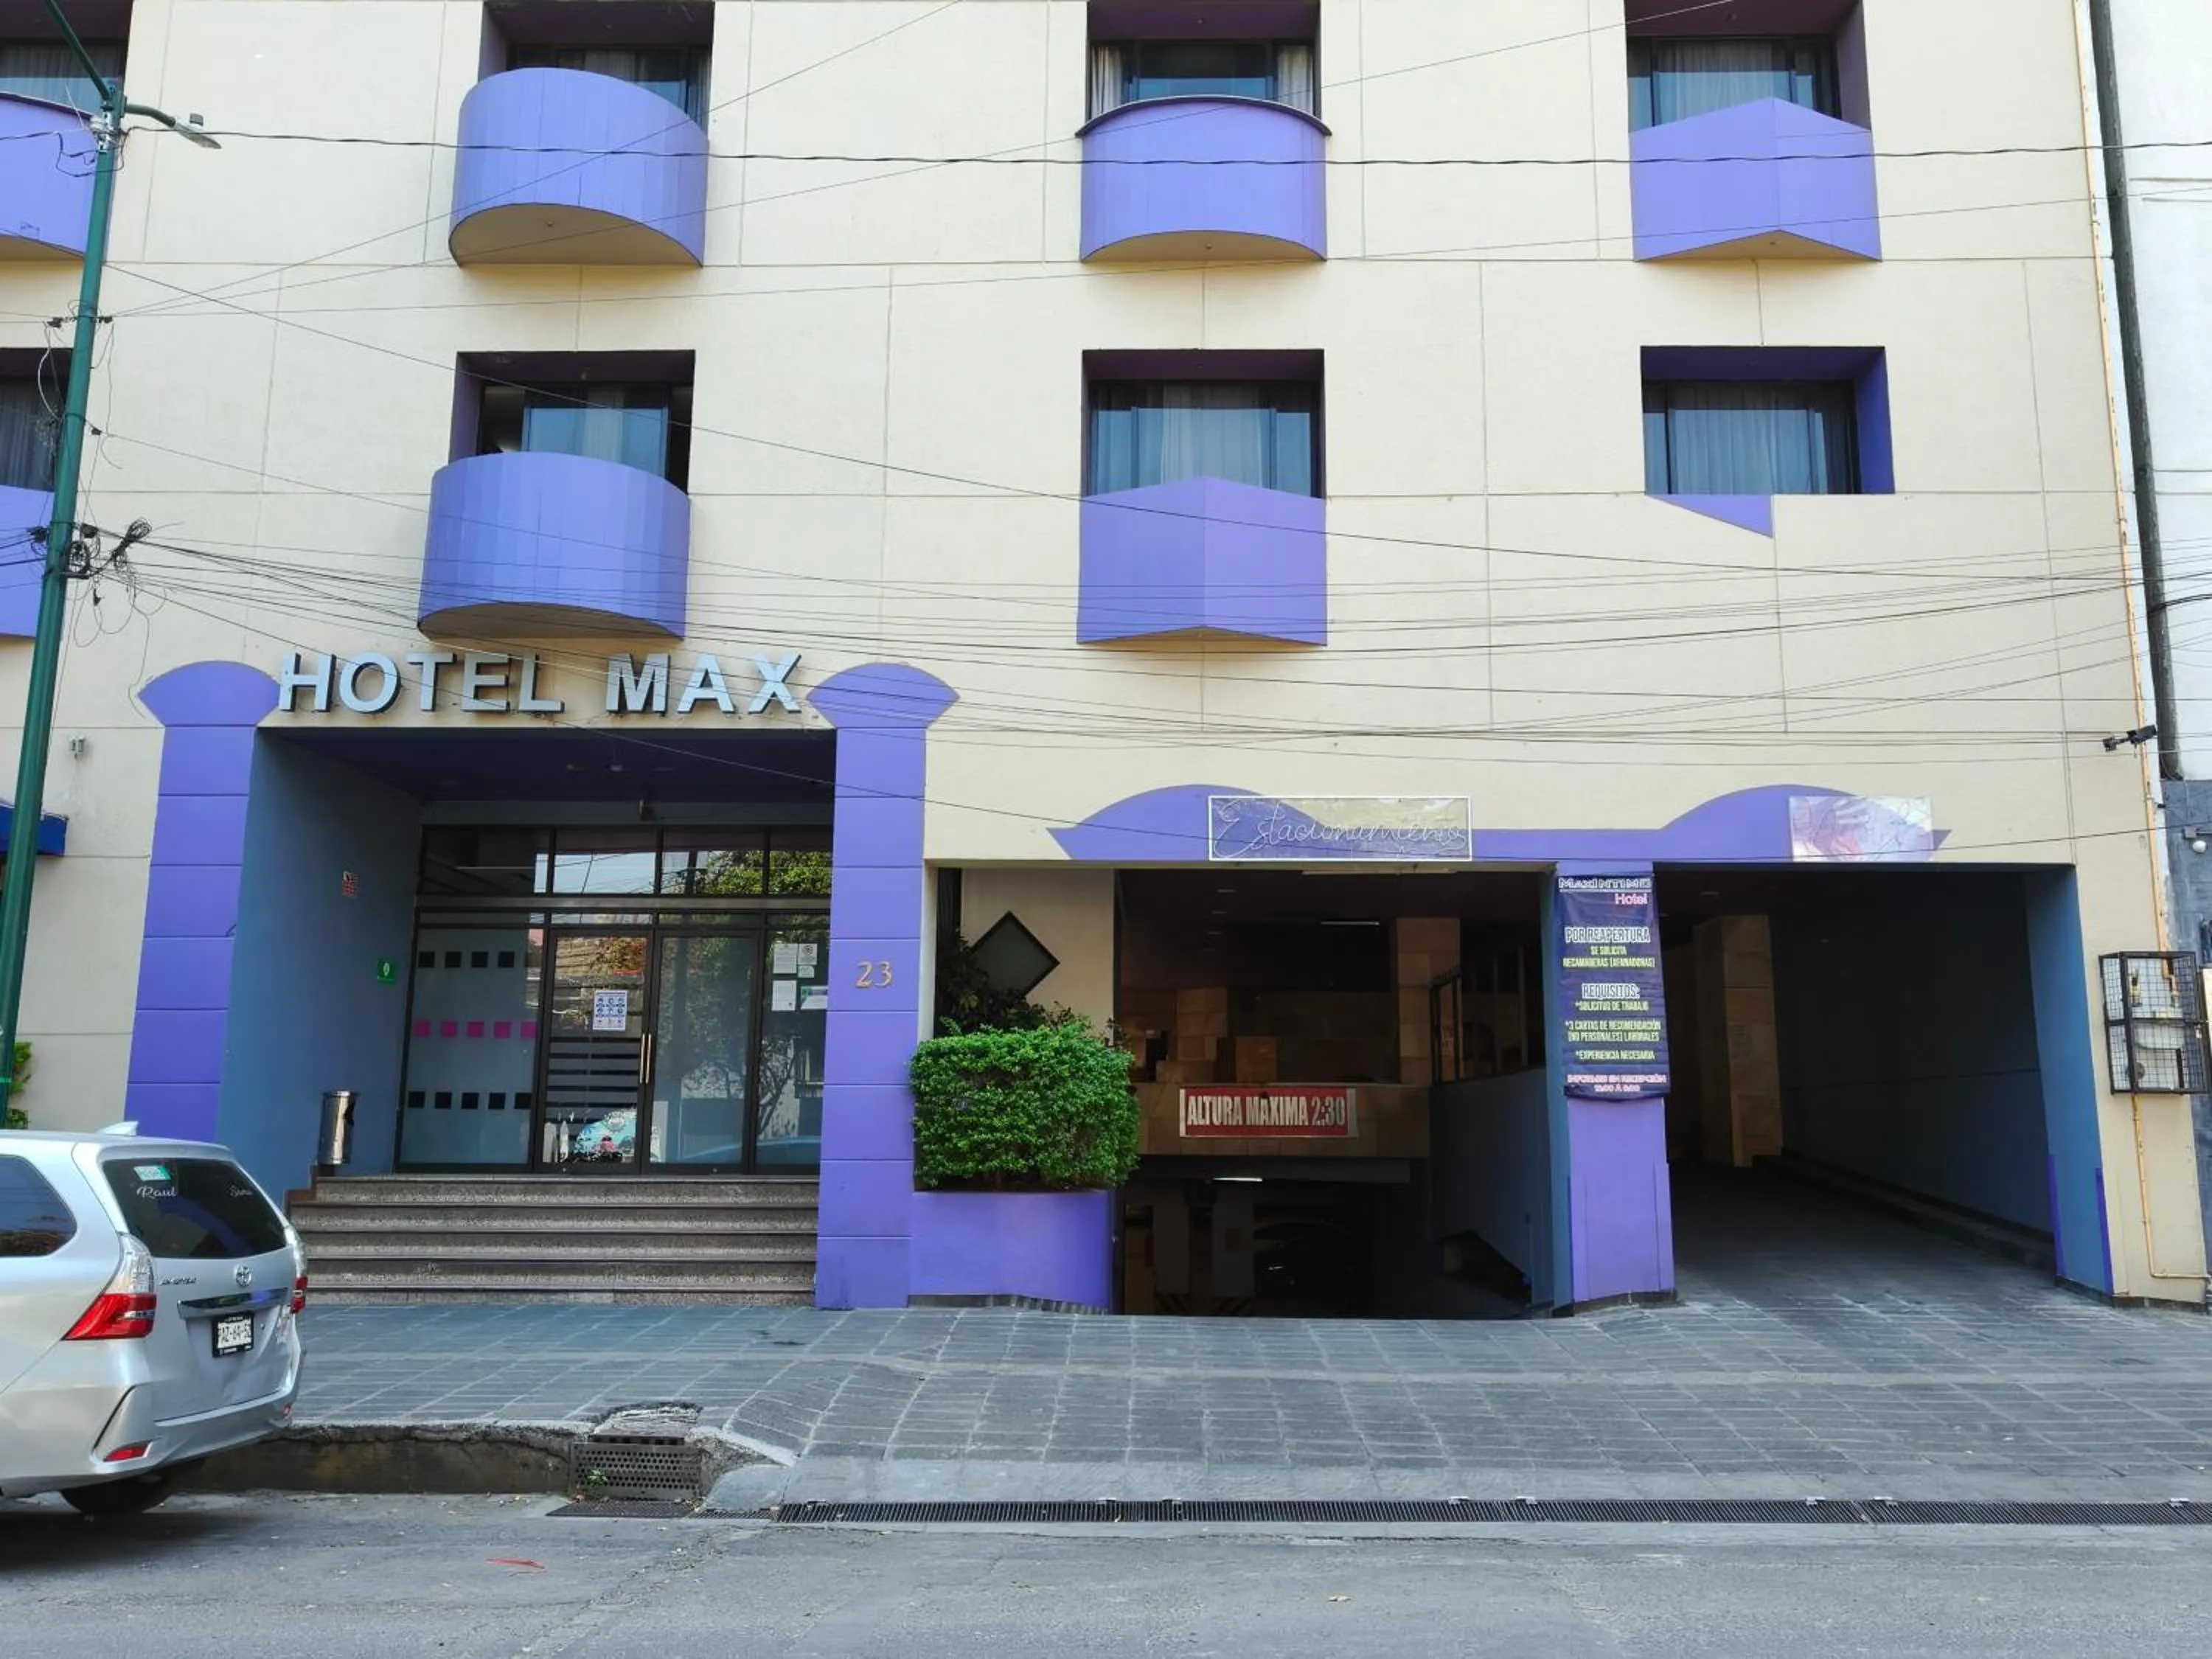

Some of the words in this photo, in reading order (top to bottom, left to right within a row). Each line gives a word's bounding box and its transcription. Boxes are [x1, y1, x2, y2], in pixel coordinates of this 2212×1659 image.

[278, 653, 565, 713] HOTEL
[605, 653, 802, 714] MAX
[1615, 893, 1648, 905] Hotel
[1565, 927, 1585, 943] POR
[1586, 927, 1651, 943] REAPERTURA
[855, 961, 892, 988] 23
[1582, 983, 1640, 999] REQUISITOS:
[1187, 1095, 1243, 1126] ALTURA
[1310, 1096, 1346, 1127] 2:30
